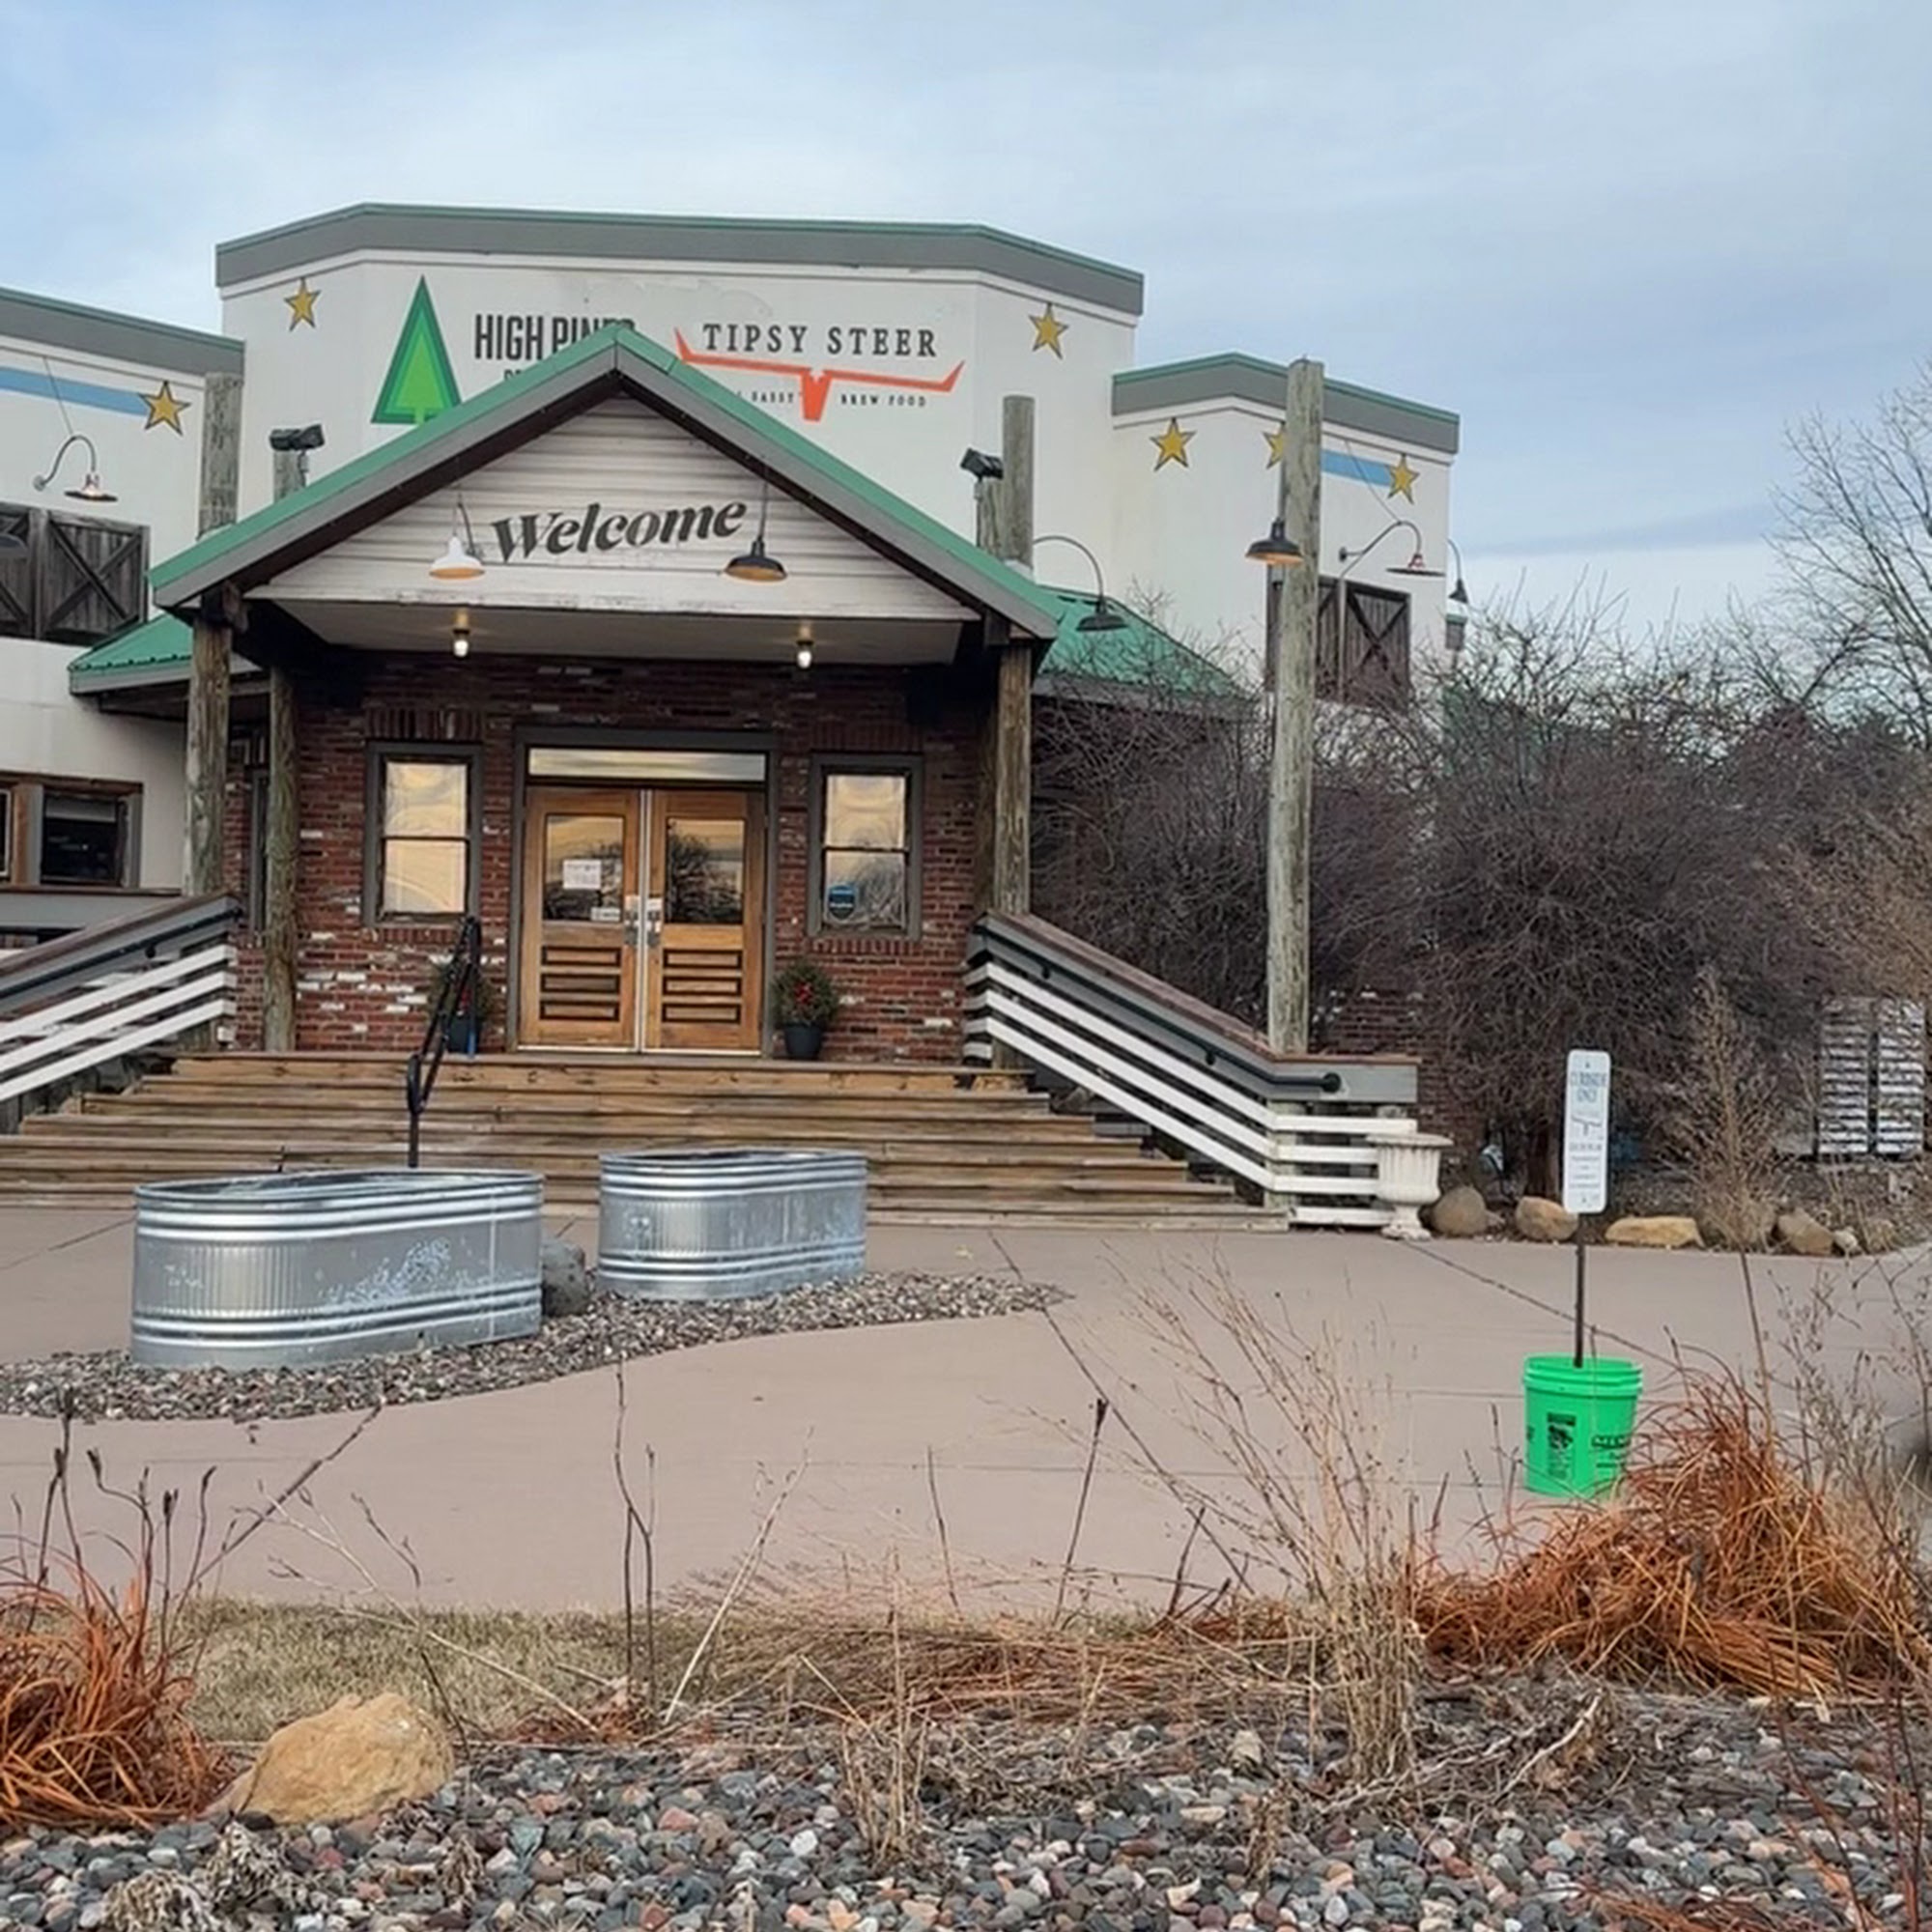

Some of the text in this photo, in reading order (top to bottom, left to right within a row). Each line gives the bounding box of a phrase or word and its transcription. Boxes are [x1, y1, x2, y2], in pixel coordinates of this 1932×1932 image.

[475, 314, 544, 360] HIGH
[703, 324, 937, 357] TIPSY STEER
[491, 501, 747, 563] Welcome
